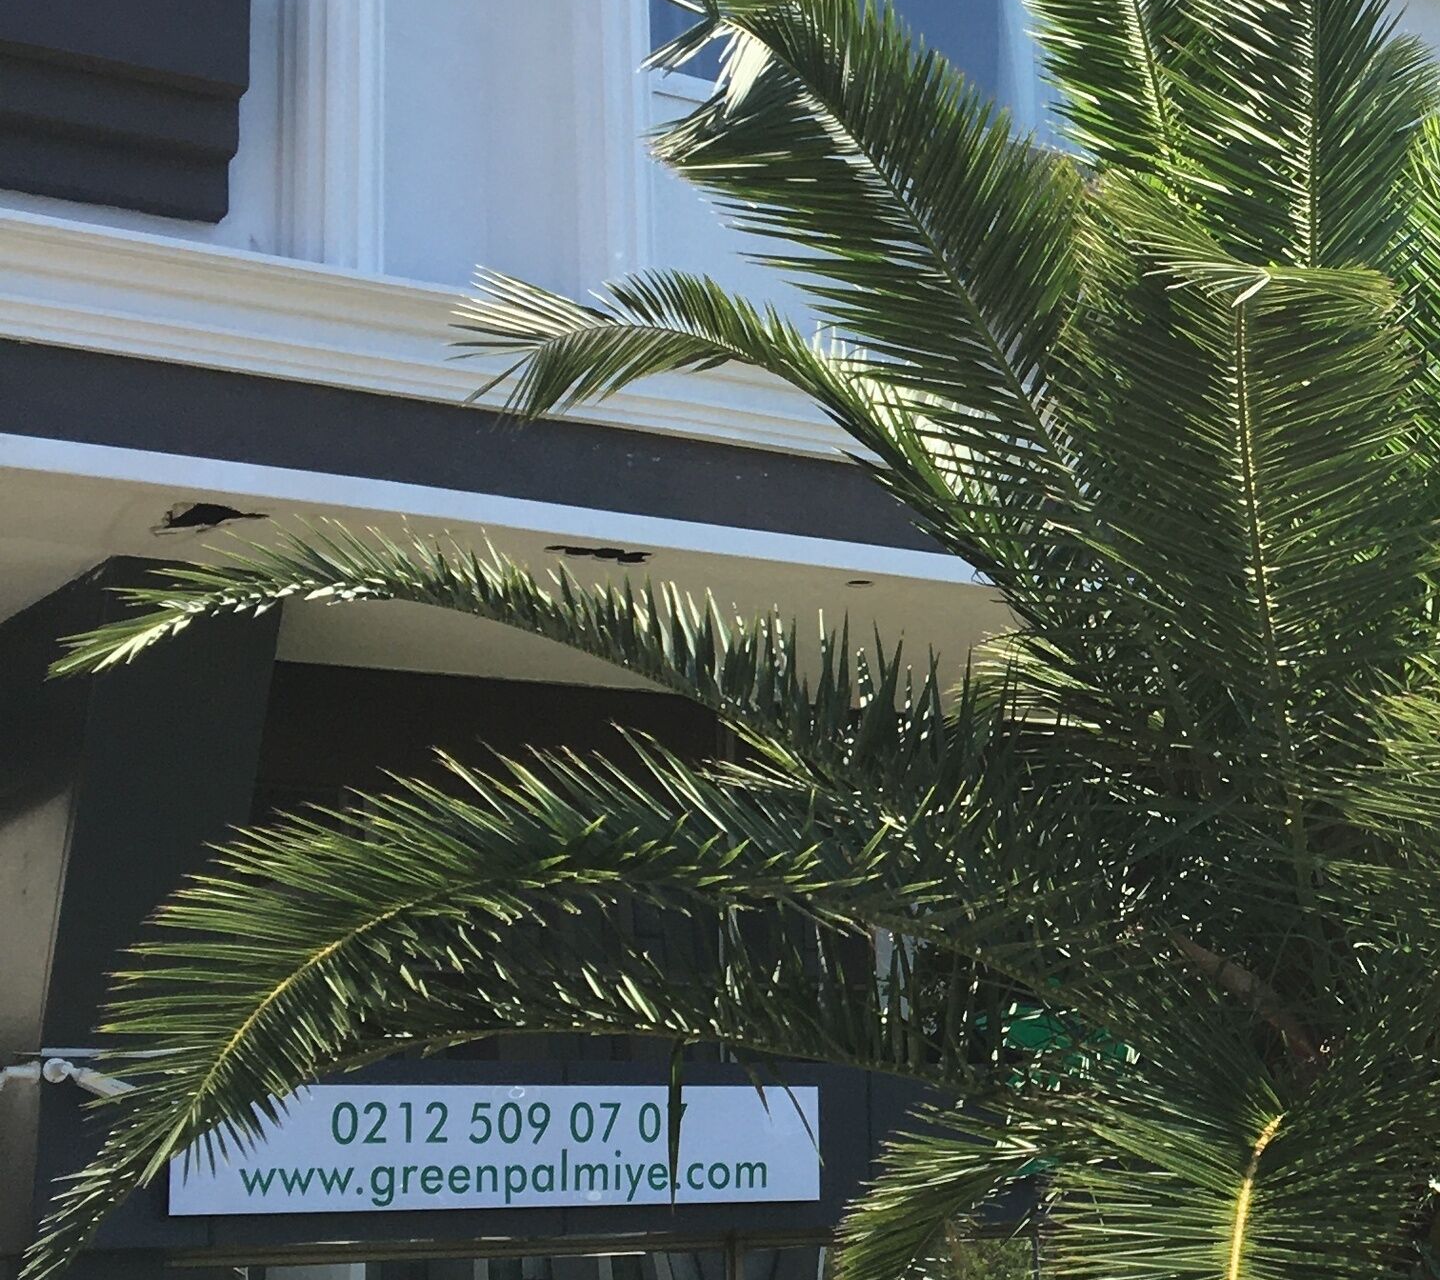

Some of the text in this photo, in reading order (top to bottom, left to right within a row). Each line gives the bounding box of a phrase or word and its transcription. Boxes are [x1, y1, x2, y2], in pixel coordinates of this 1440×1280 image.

[332, 1101, 448, 1145] 0212
[469, 1102, 551, 1144] 509
[570, 1101, 621, 1143] 07
[240, 1148, 767, 1207] www.greenpalmiye.com
